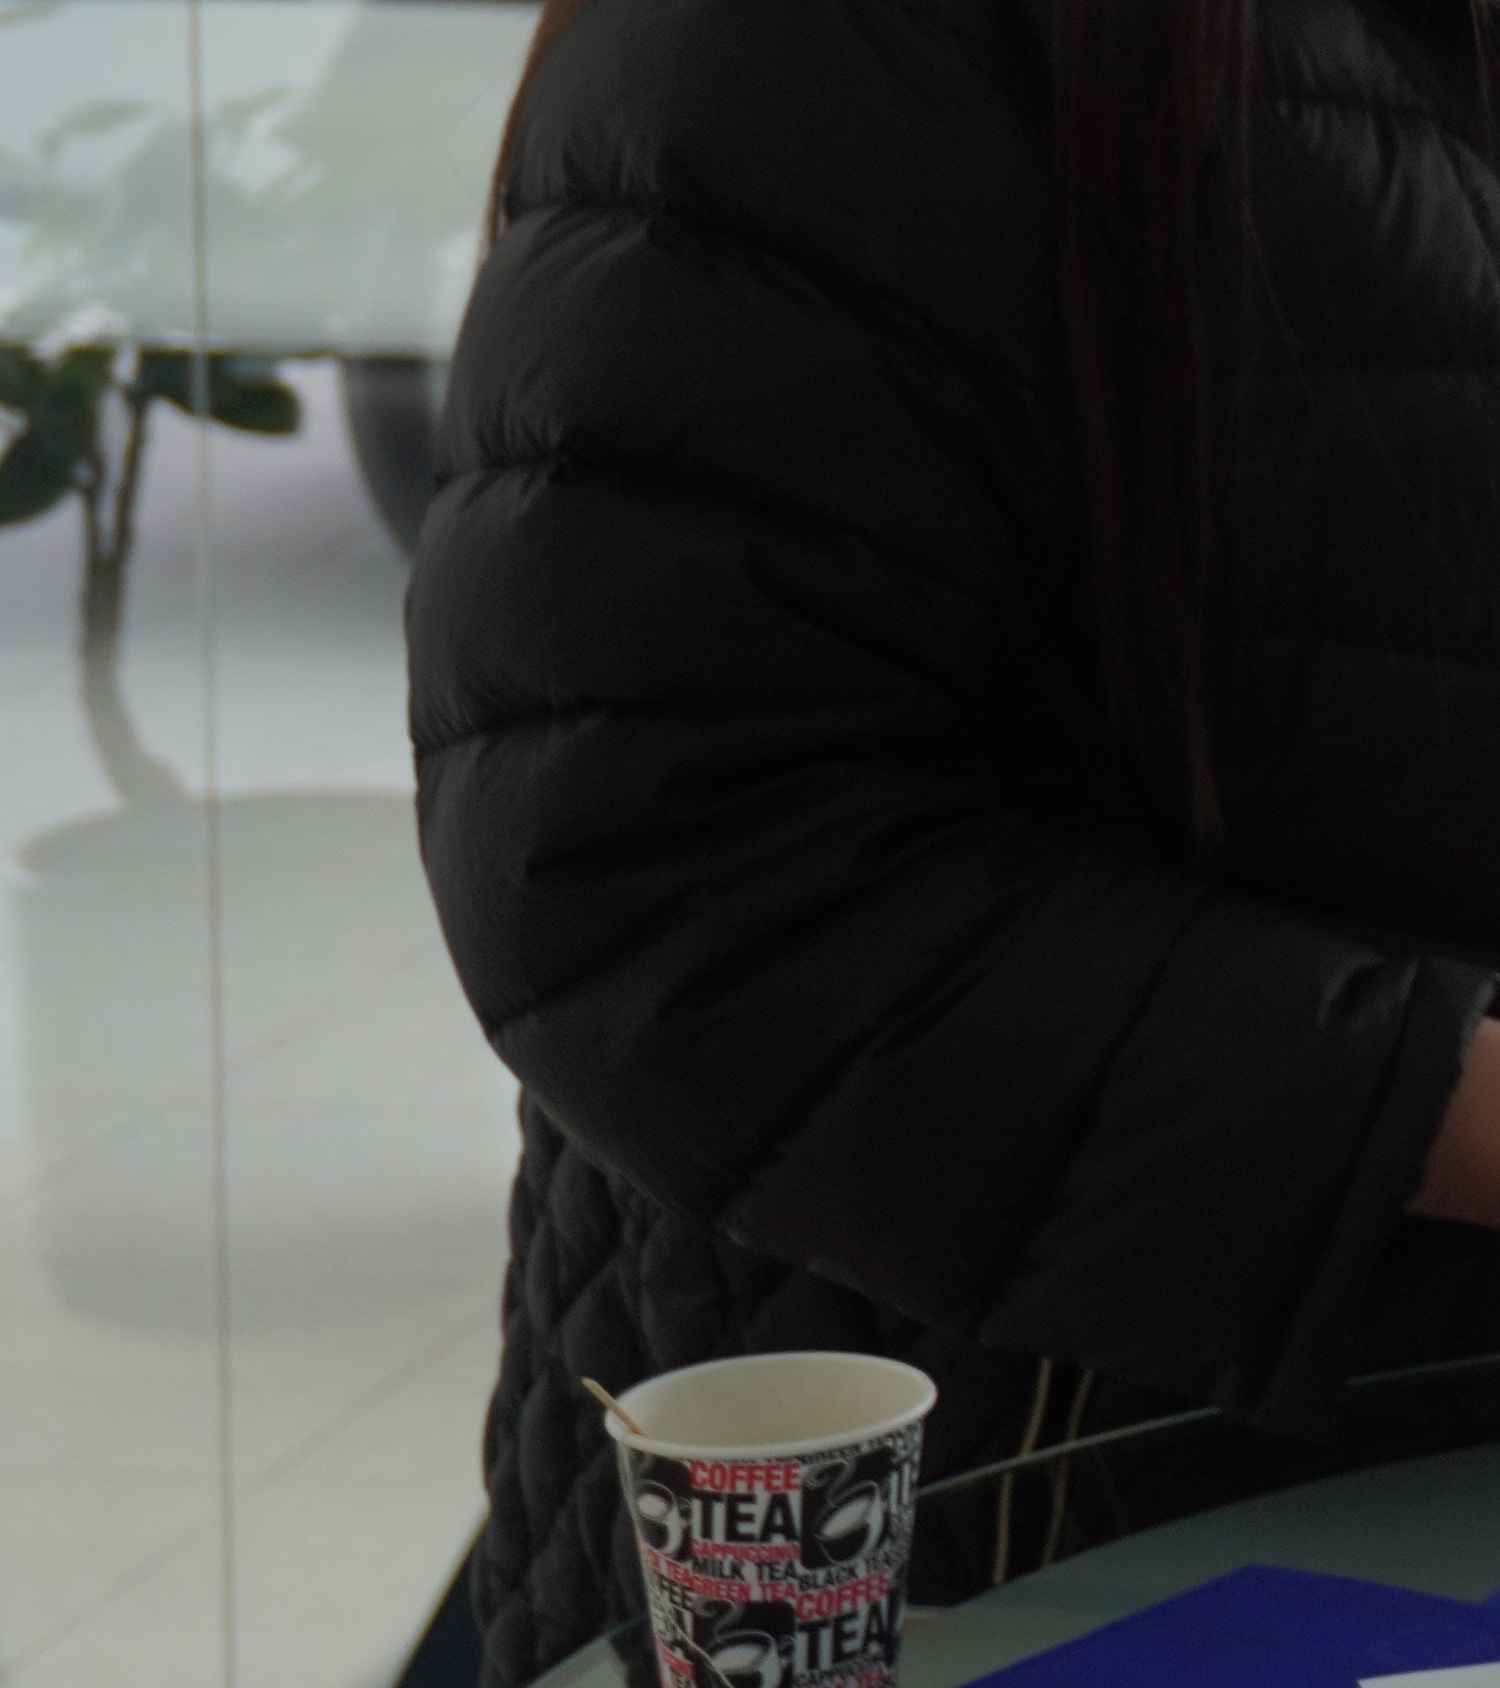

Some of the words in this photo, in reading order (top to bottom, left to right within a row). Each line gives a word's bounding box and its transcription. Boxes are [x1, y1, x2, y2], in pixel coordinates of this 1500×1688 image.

[689, 1459, 800, 1492] COFFEE
[691, 1490, 798, 1543] TEA
[758, 1562, 798, 1583] TEA
[759, 1581, 797, 1603] TEA
[796, 1570, 889, 1620] COFFEE
[797, 1601, 887, 1664] TEA
